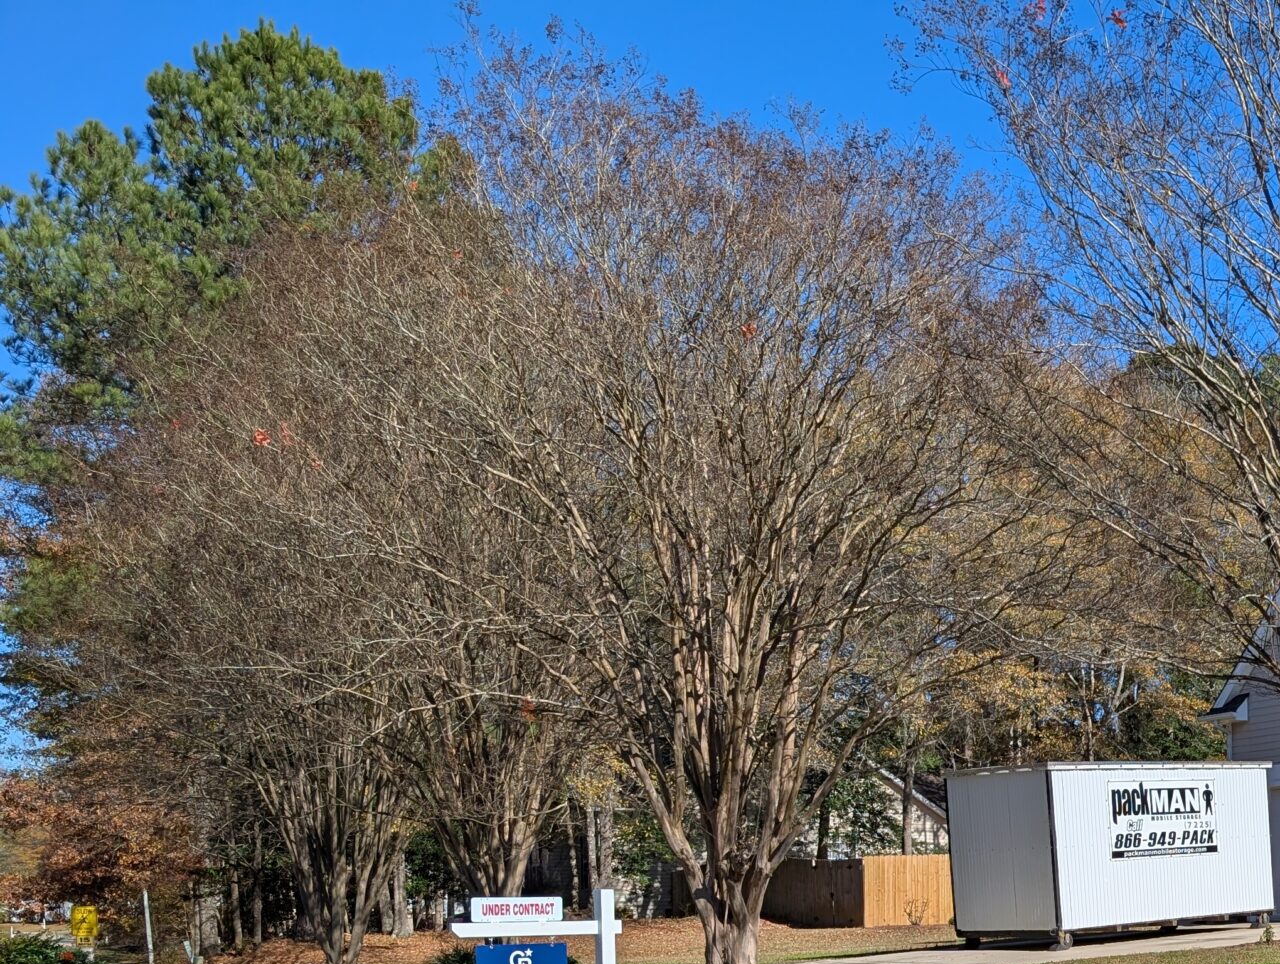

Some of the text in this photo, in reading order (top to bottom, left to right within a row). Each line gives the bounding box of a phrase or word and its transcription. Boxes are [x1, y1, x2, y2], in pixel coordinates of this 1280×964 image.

[1127, 819, 1143, 832] Call
[1114, 829, 1215, 849] 866-949-PACK
[1123, 847, 1207, 857] packmanmobilestorage.com
[481, 903, 555, 916] UNDER CONTRACT
